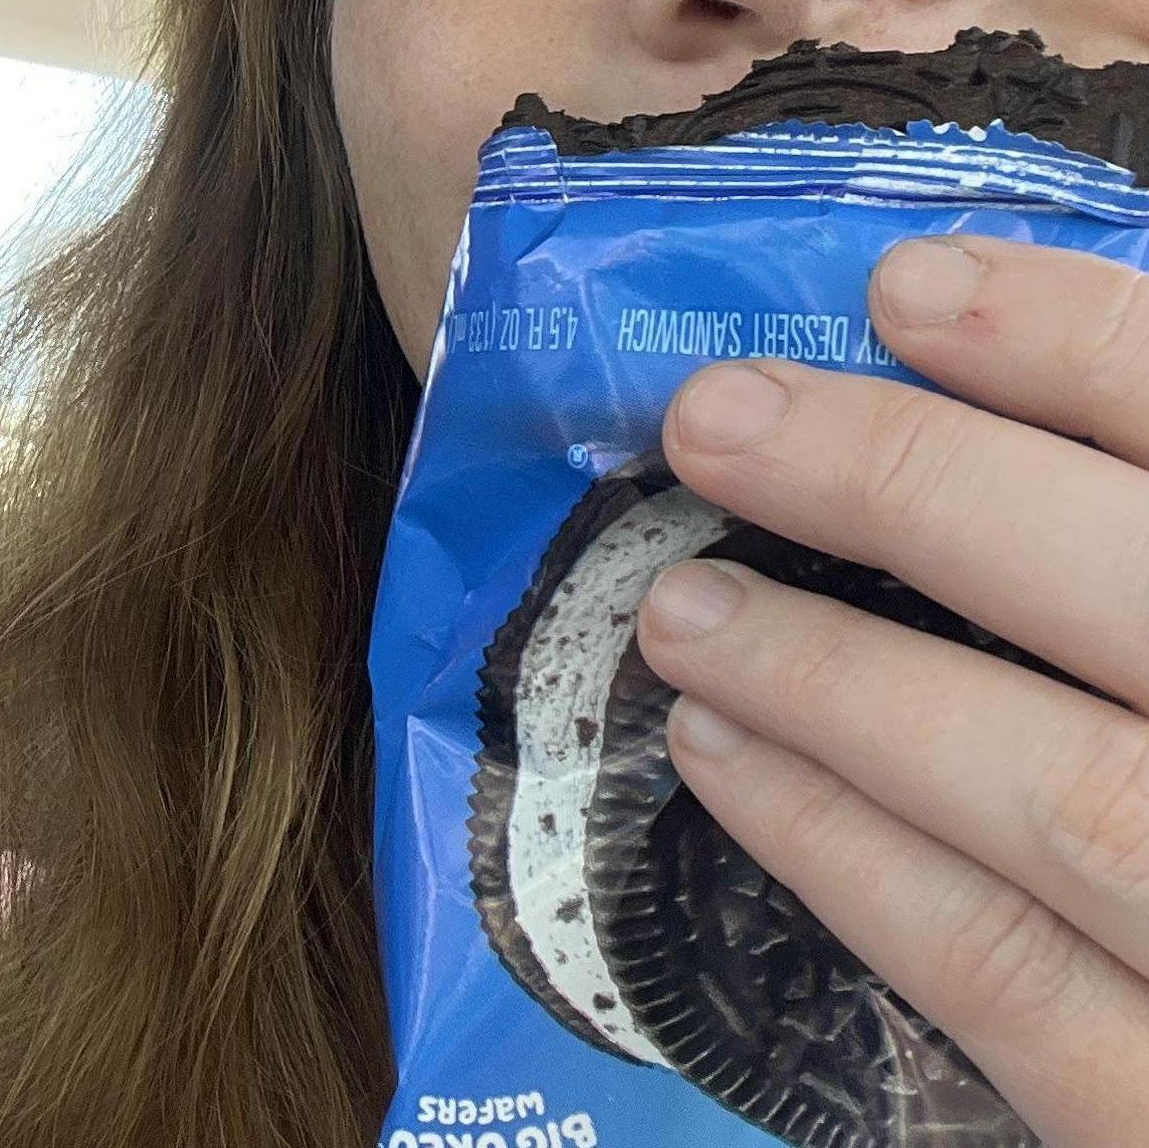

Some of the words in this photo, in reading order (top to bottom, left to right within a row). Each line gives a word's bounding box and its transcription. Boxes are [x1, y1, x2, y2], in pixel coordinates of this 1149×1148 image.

[499, 307, 521, 351] OZ
[526, 307, 544, 351] FL
[549, 306, 579, 351] 4.5
[617, 308, 742, 357] SANDWICH
[749, 313, 849, 363] DESSERT
